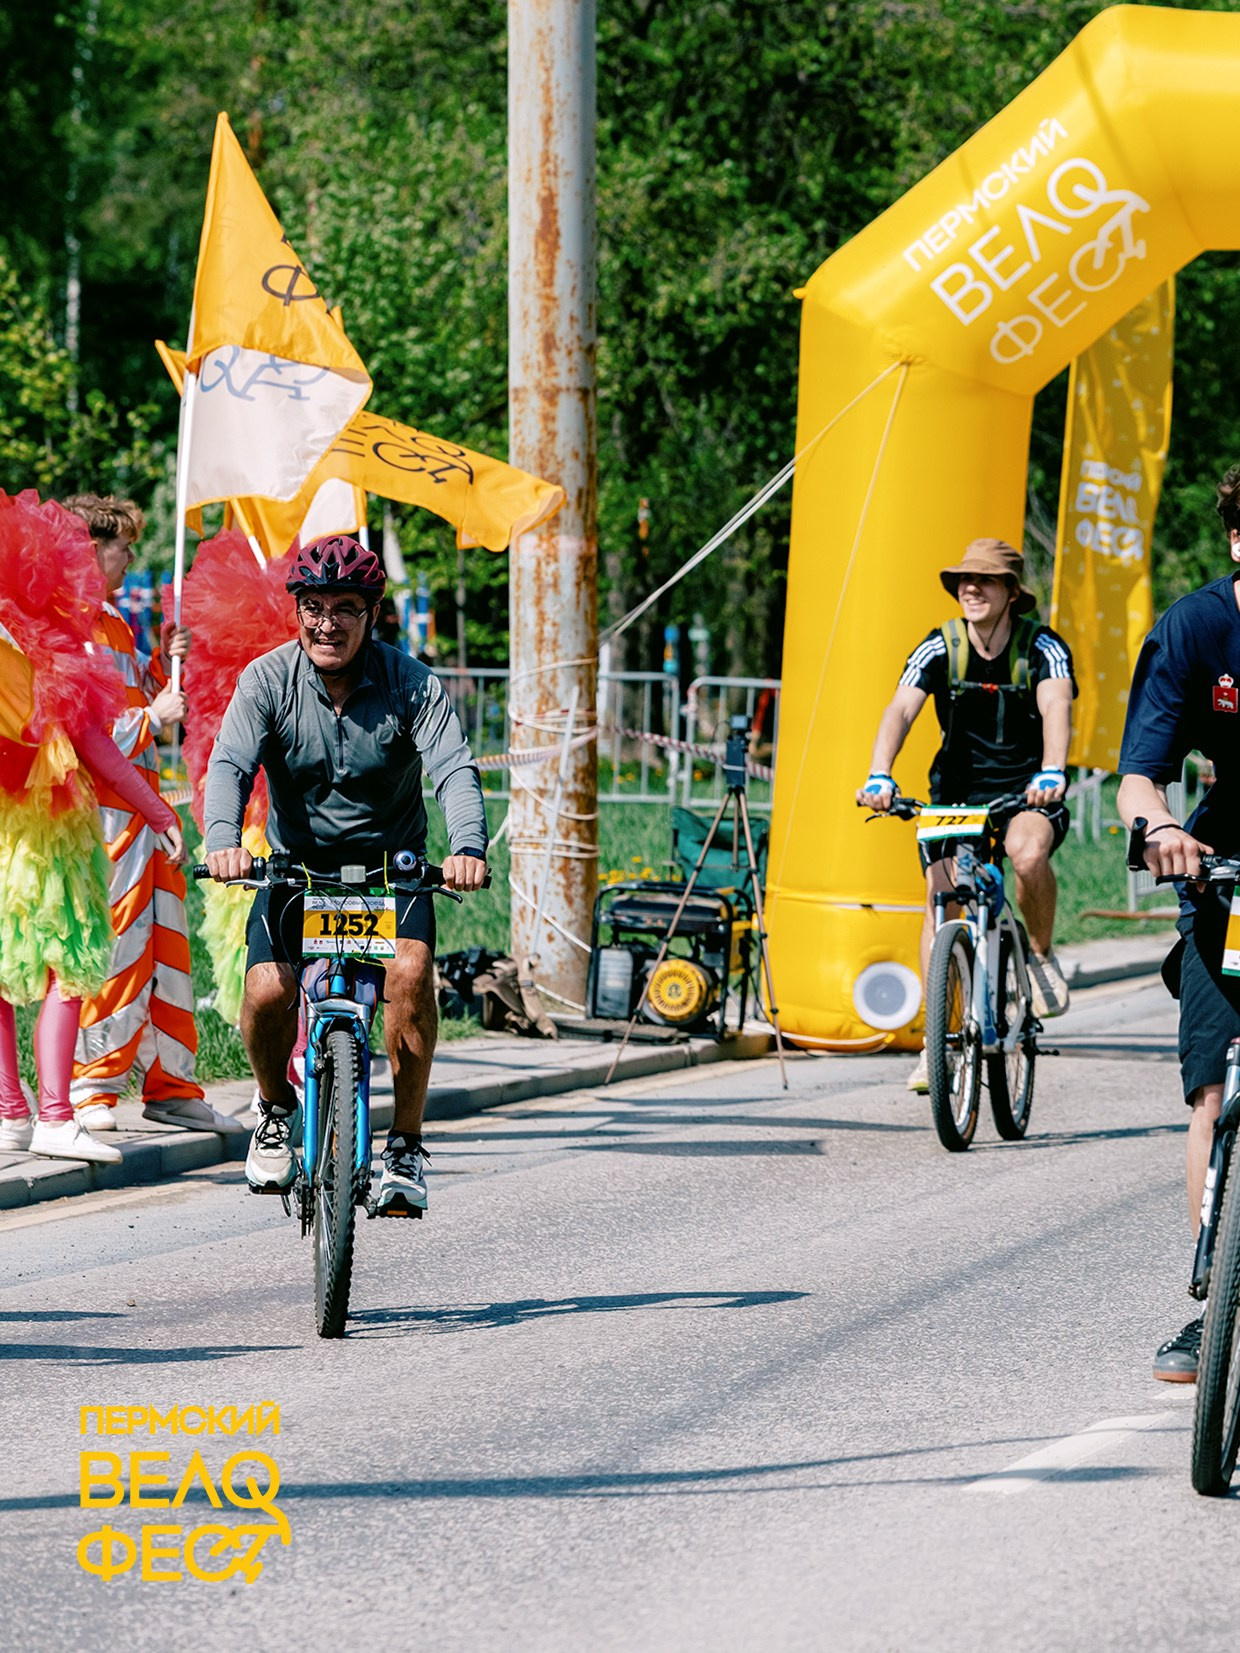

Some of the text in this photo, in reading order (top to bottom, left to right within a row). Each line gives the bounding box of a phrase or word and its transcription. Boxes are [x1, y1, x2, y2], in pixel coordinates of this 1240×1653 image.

[903, 118, 1069, 272] ПЕРМСКИЙ
[935, 814, 969, 827] 727
[319, 913, 379, 936] 1252
